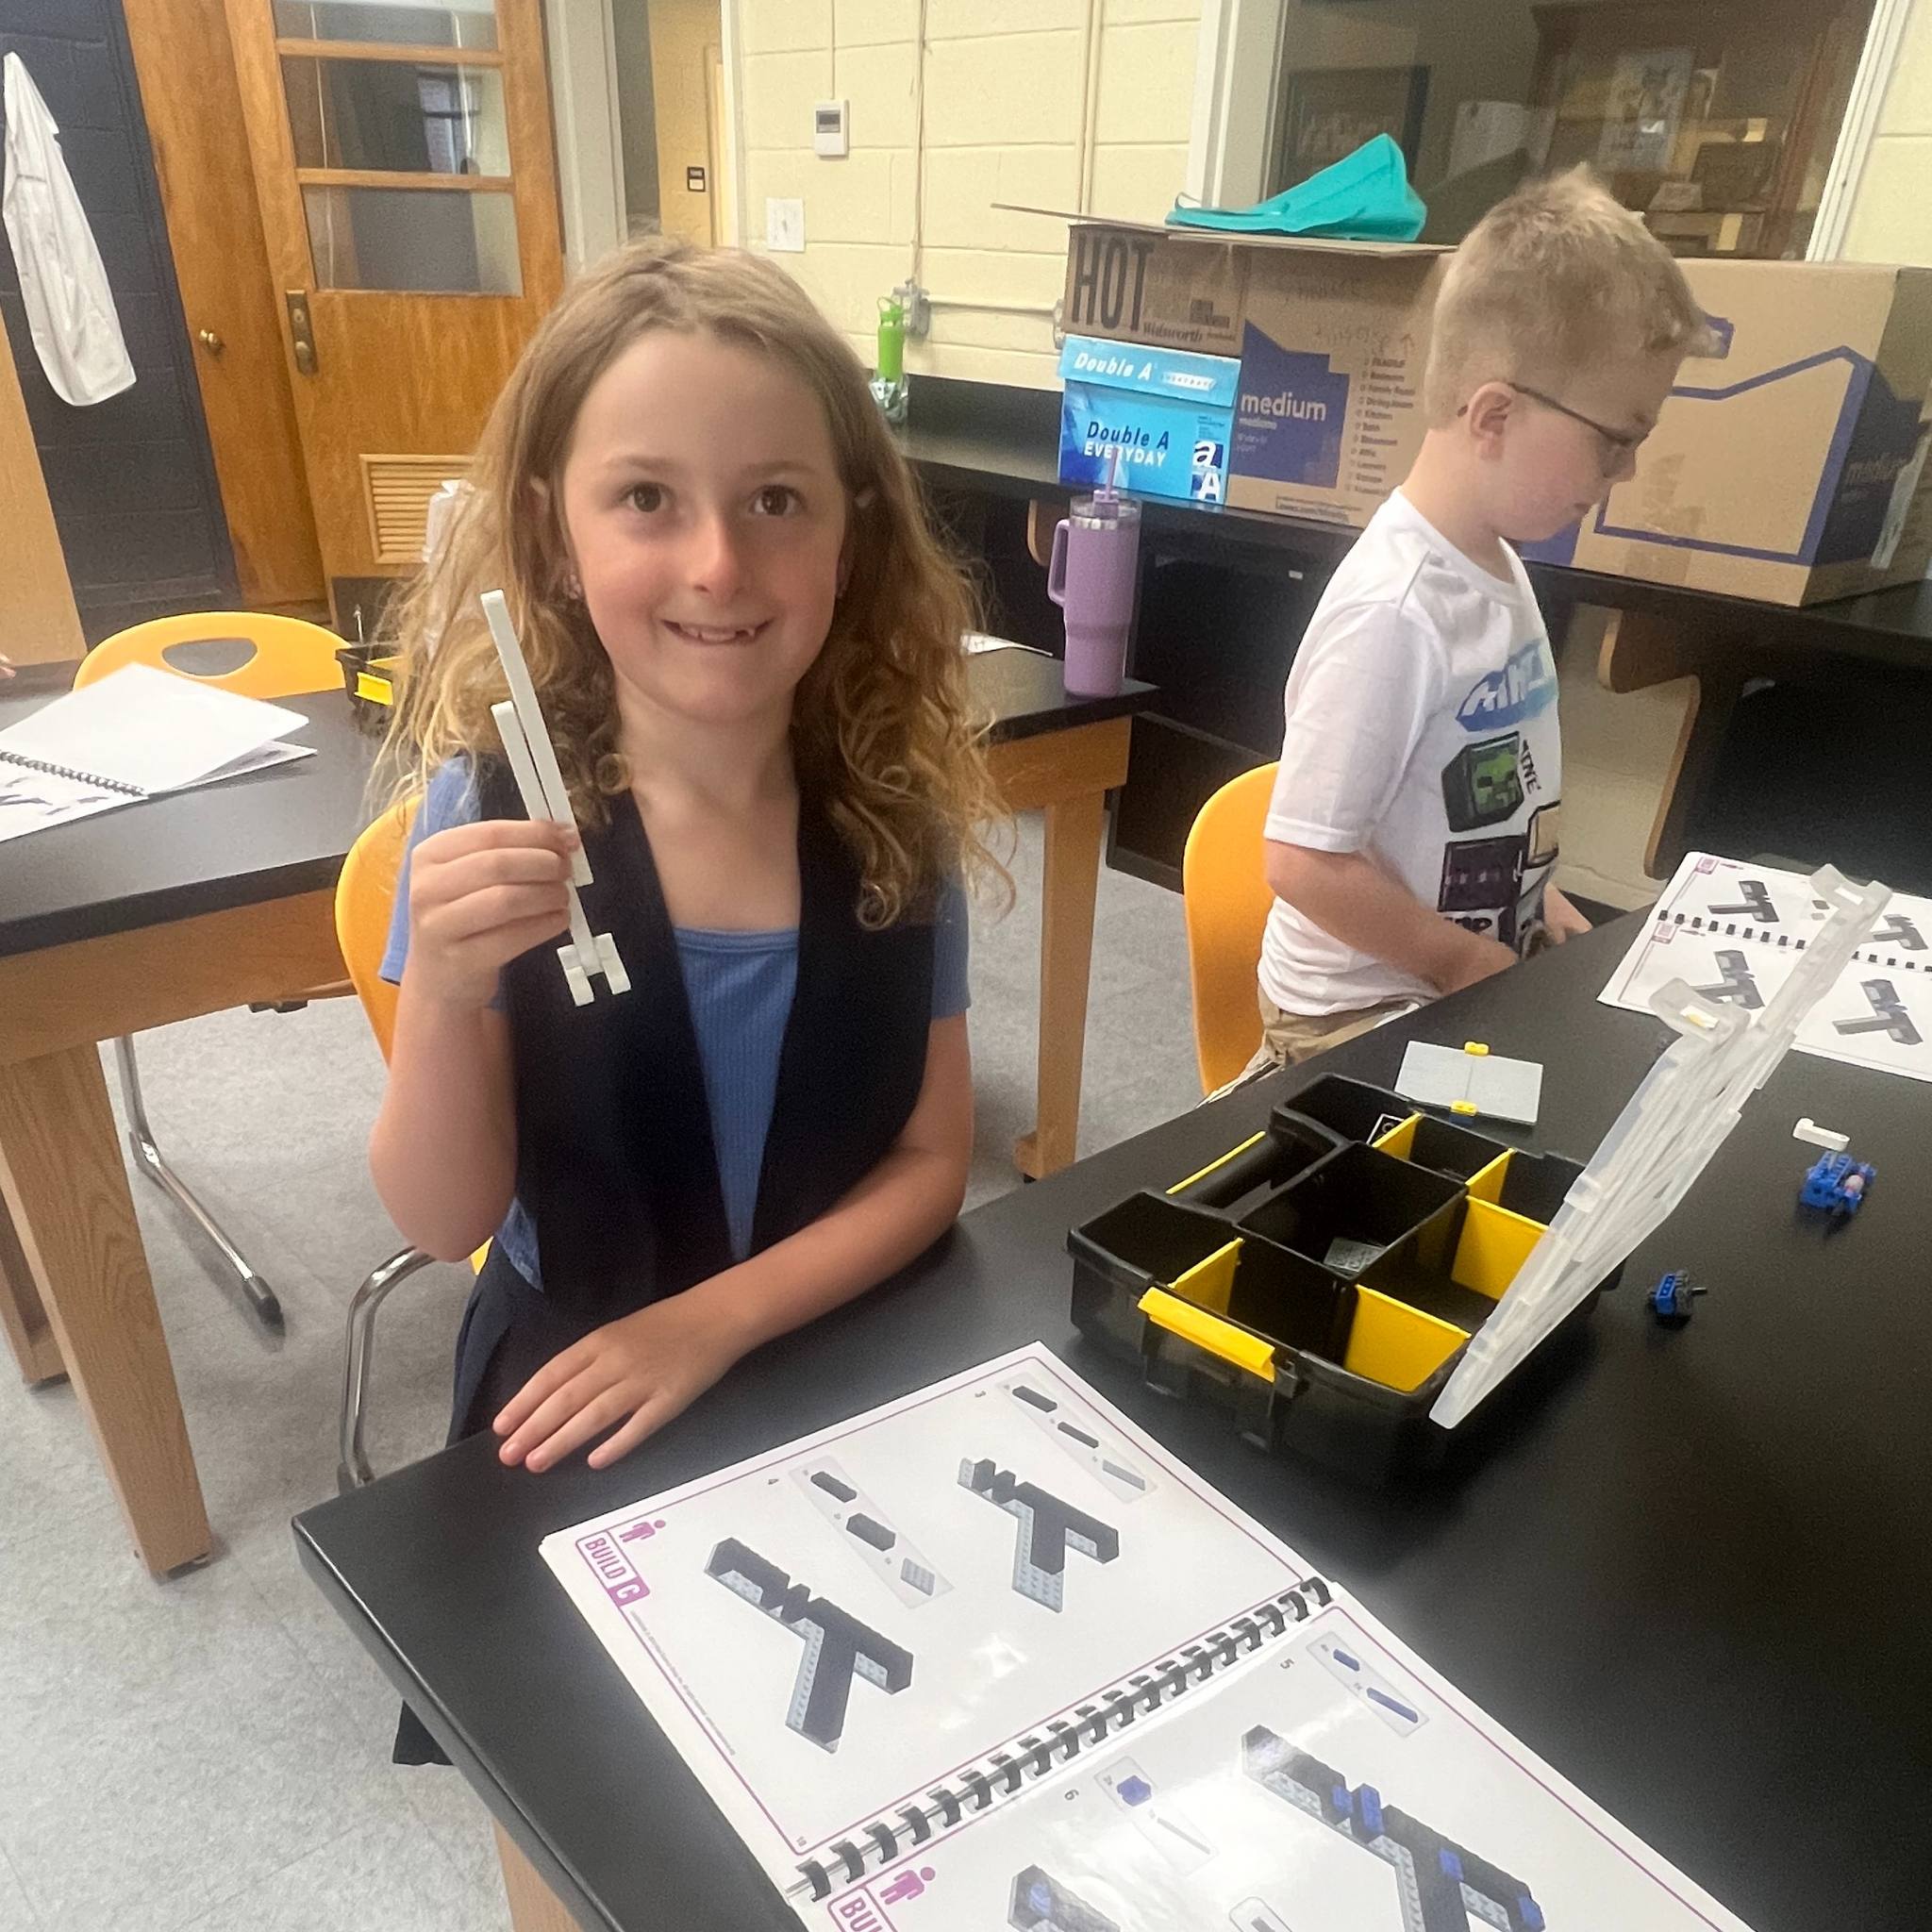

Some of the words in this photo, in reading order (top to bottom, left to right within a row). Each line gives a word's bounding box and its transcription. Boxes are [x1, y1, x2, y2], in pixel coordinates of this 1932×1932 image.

[1072, 232, 1155, 332] HOT
[1074, 353, 1134, 377] Double
[1137, 362, 1153, 381] A
[1241, 391, 1326, 422] medium
[1087, 421, 1151, 447] Double
[1157, 430, 1171, 451] A
[1084, 441, 1167, 468] EVERYDAY
[585, 1537, 627, 1579] BUILD
[1064, 1789, 1080, 1802] 6
